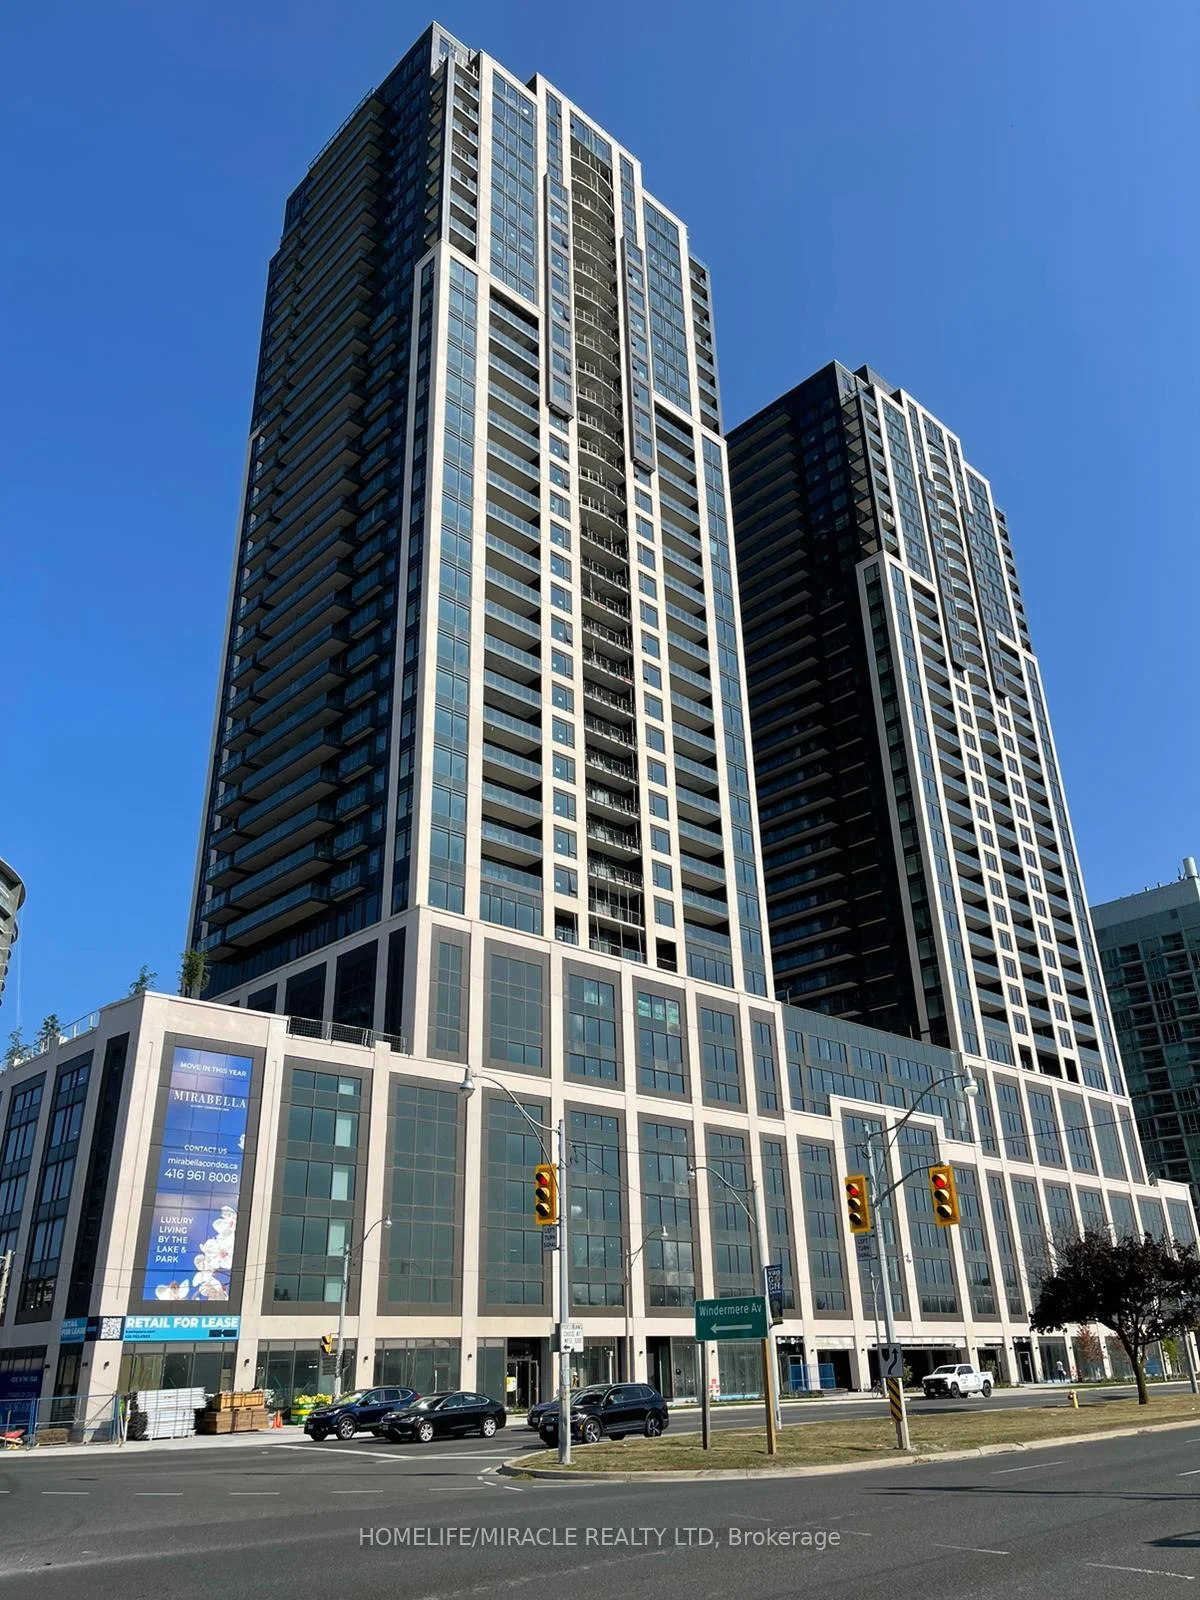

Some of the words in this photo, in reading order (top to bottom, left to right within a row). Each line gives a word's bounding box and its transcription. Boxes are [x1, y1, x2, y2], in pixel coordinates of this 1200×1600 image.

[180, 1062, 200, 1070] MOVE
[212, 1066, 228, 1074] THIS
[229, 1069, 247, 1077] YEAR
[174, 1090, 246, 1108] MIRABELLA
[184, 1144, 216, 1154] CONTACT
[218, 1147, 228, 1155] US
[167, 1157, 238, 1170] mirabellacondos.ca
[164, 1168, 184, 1180] 416
[187, 1170, 205, 1181] 961
[208, 1171, 238, 1184] 8008
[160, 1216, 194, 1225] LUXURY
[159, 1226, 188, 1234] LIVING
[158, 1235, 170, 1243] BY
[171, 1236, 189, 1244] THE
[156, 1246, 179, 1254] LAKE
[155, 1255, 179, 1263] PARK
[699, 1305, 749, 1317] Windermere
[751, 1302, 762, 1313] Av
[126, 1317, 171, 1329] RETAIL
[173, 1317, 198, 1329] FOR
[201, 1317, 239, 1328] LEASE
